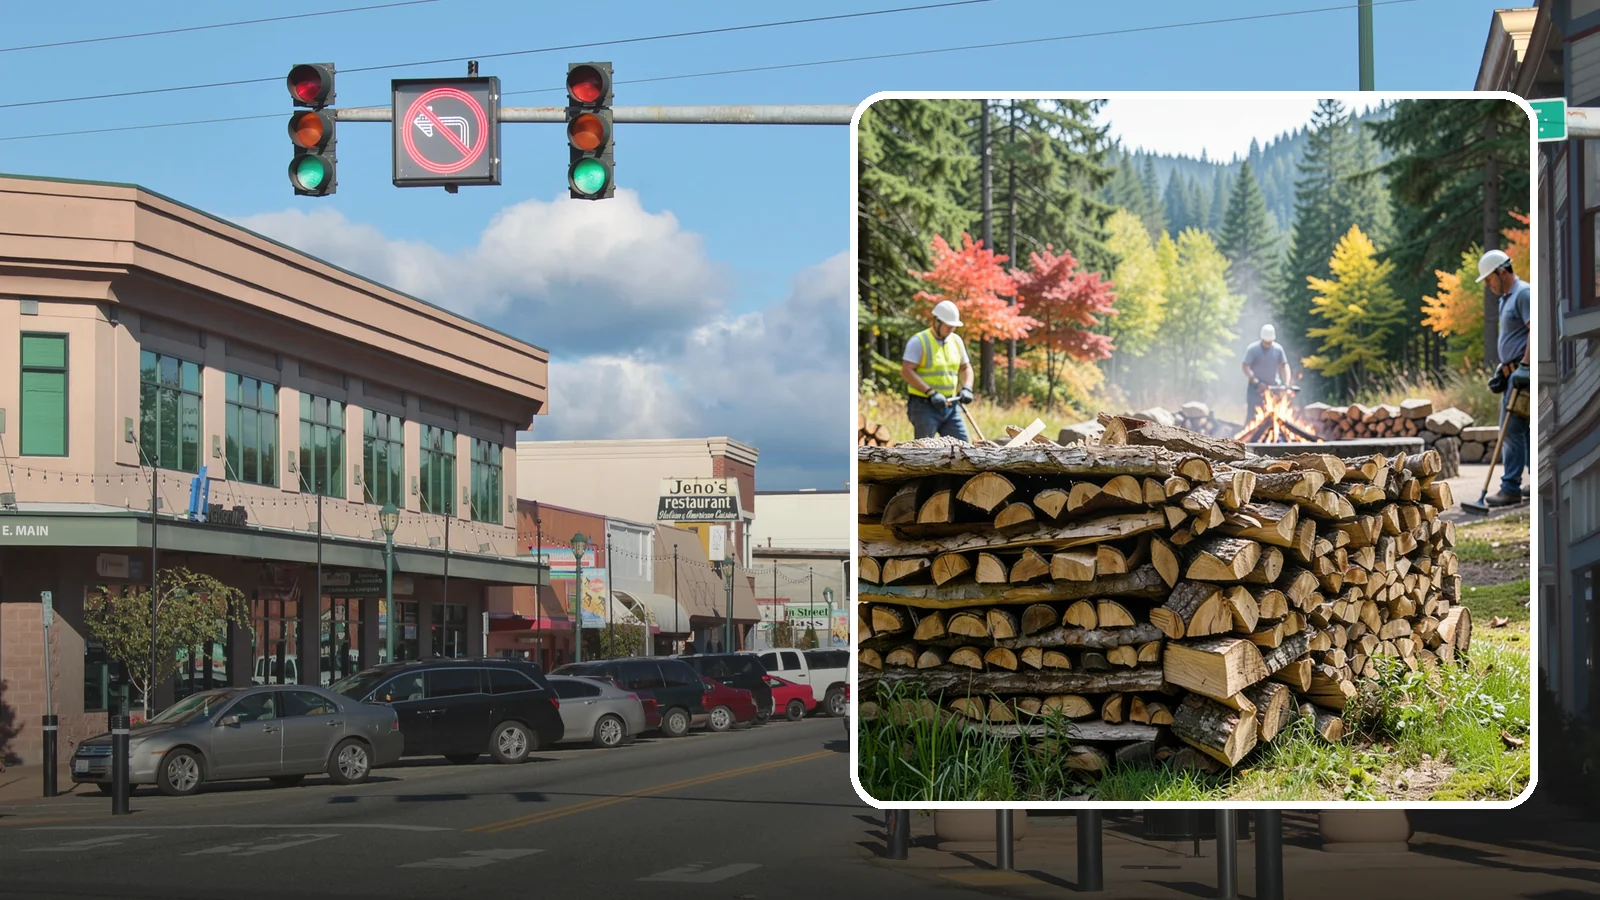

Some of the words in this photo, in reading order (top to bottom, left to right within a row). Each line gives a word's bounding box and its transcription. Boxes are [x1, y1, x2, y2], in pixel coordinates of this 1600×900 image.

[670, 480, 727, 494] Jeno's
[665, 496, 731, 509] restaurant
[658, 510, 682, 520] Italian
[686, 509, 714, 519] American
[714, 509, 737, 519] Cuisine
[2, 525, 13, 536] E.
[15, 525, 49, 536] MAIN
[797, 608, 829, 617] Street
[790, 619, 823, 627] lass
